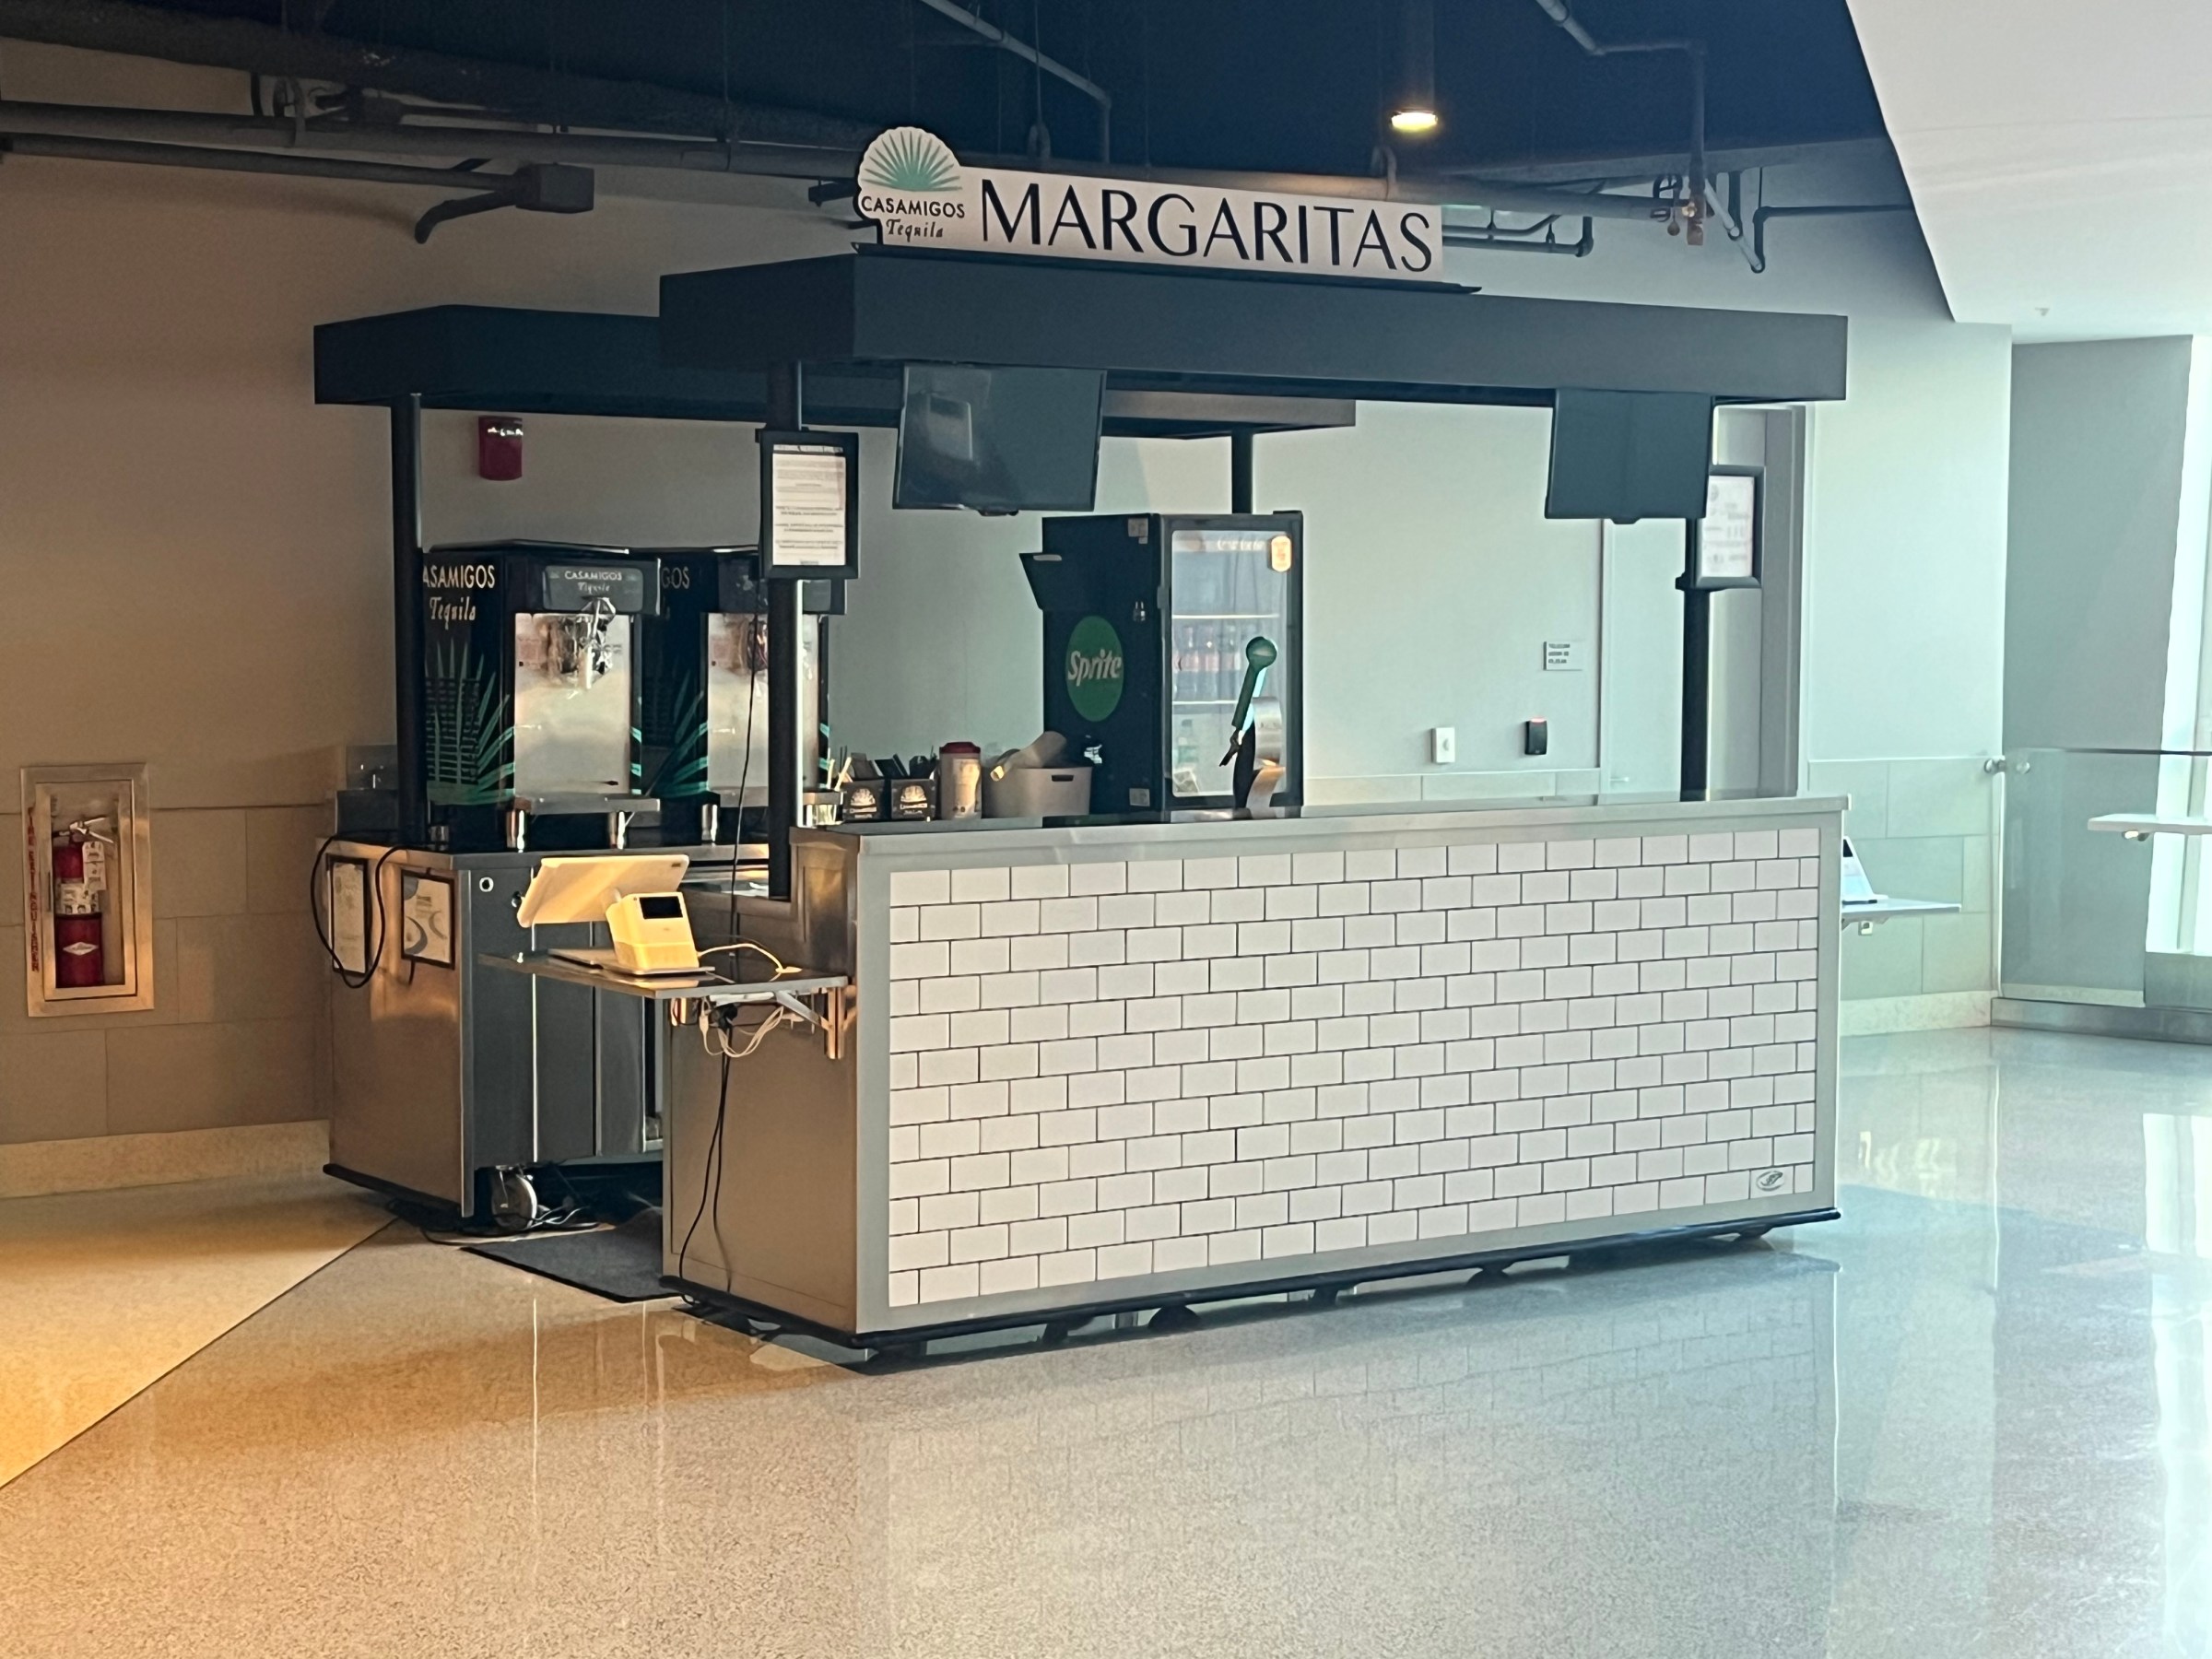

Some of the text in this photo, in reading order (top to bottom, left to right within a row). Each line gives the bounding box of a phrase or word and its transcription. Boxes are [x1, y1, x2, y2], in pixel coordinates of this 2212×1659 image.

[861, 195, 965, 218] CASAMIGOS
[886, 218, 944, 242] Tequila
[981, 178, 1433, 273] MARGARITAS
[422, 564, 495, 589] ASAMIGOS
[564, 571, 623, 582] CASAMIGOS
[429, 595, 477, 630] Tequila
[1067, 648, 1122, 687] Sprite
